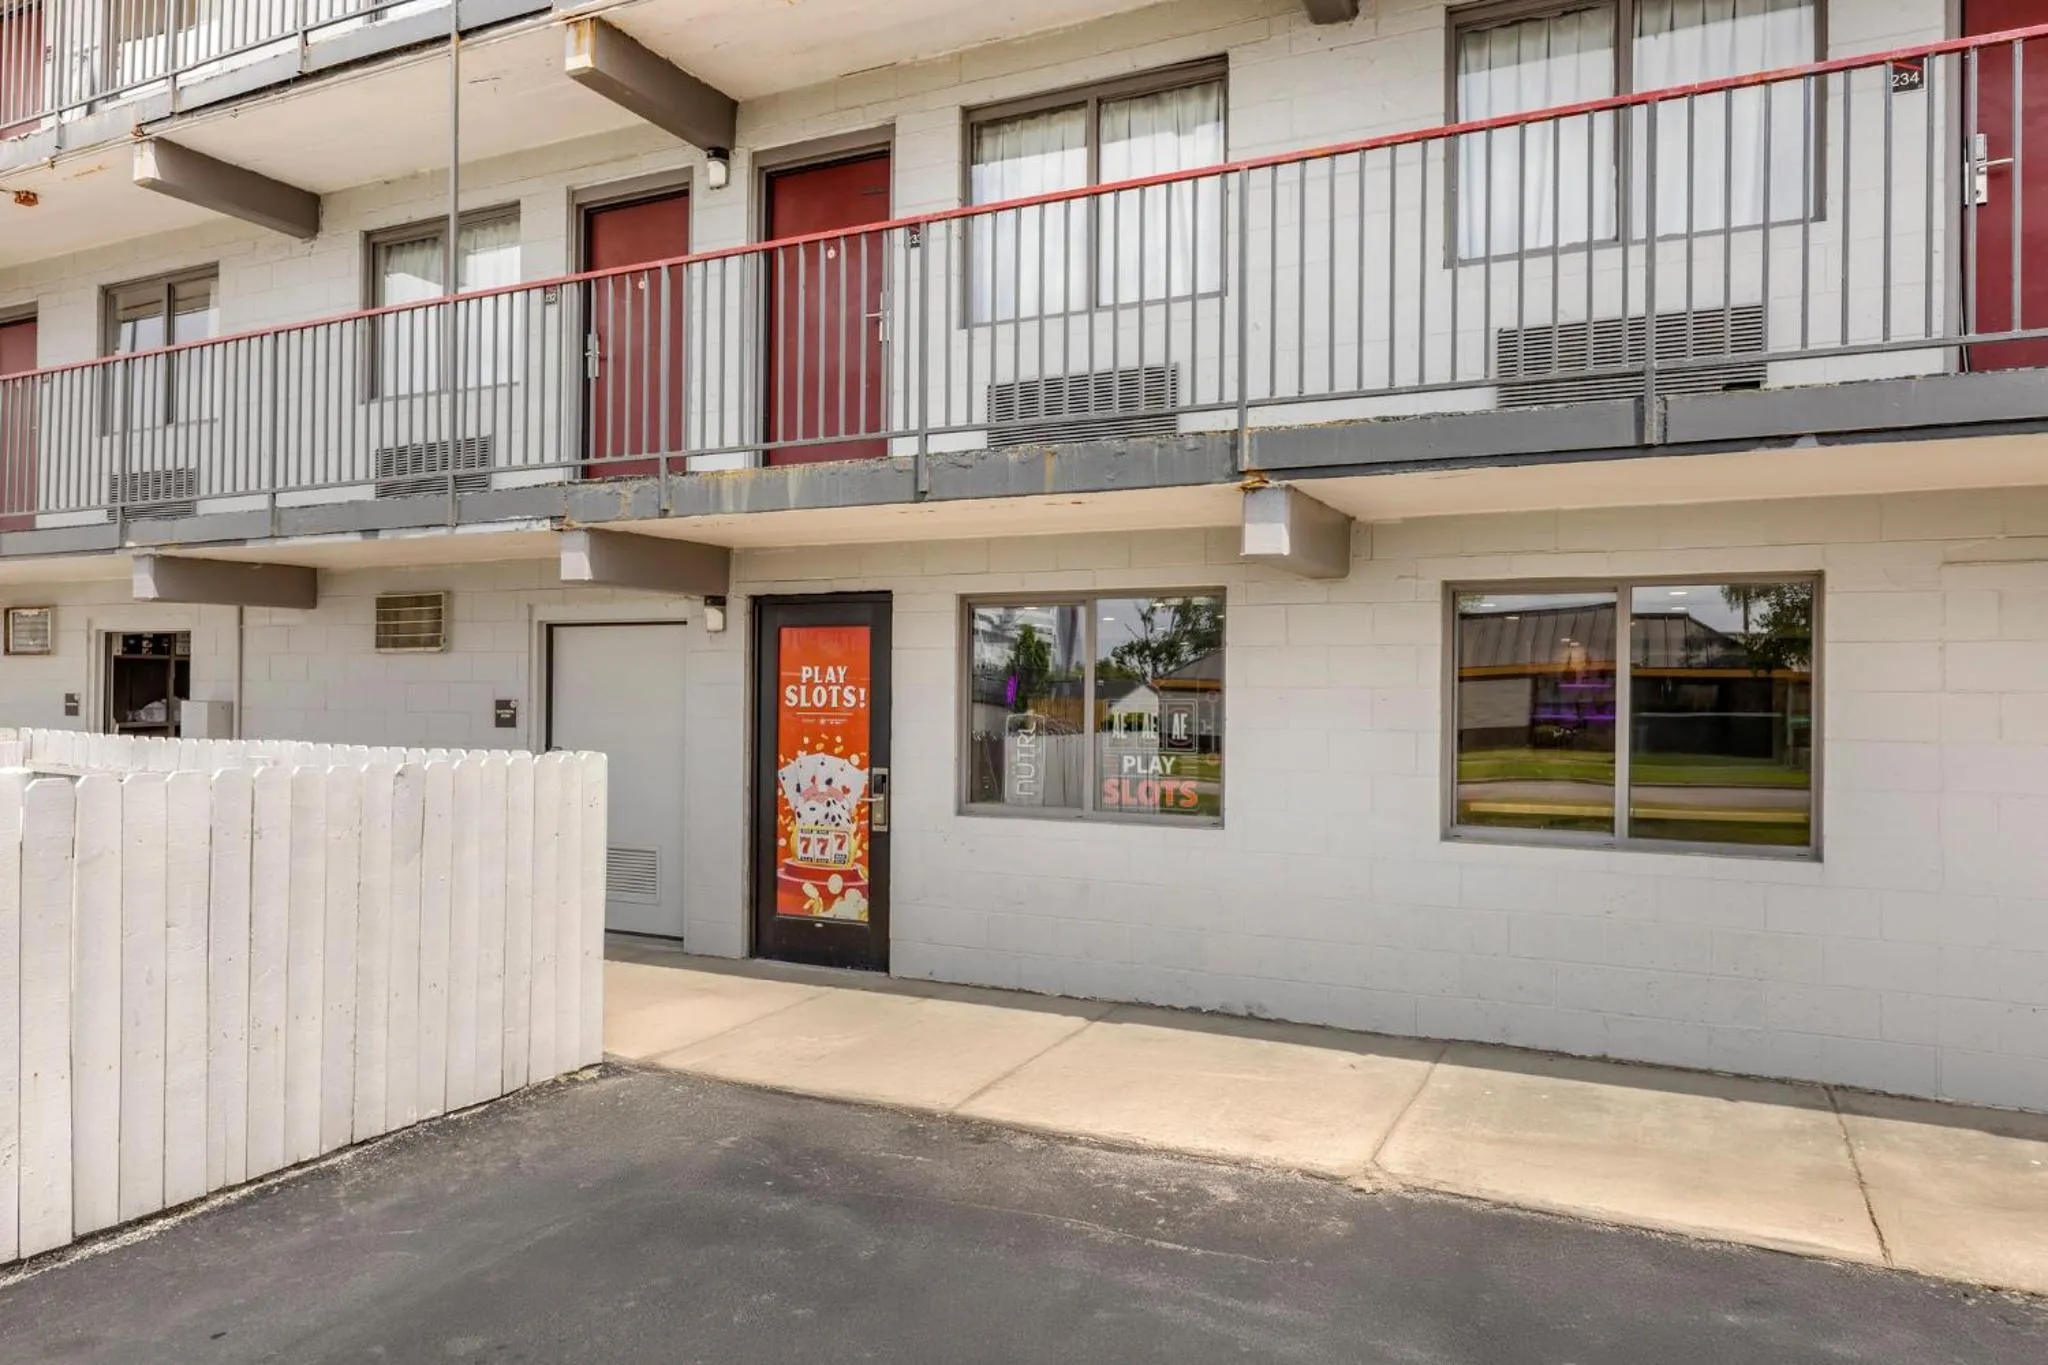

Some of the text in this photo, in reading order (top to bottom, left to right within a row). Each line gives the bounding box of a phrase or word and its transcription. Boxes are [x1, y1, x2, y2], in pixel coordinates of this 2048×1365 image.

[1891, 71, 1920, 87] 234
[800, 665, 848, 683] PLAY
[784, 685, 867, 708] SLOTS!
[1172, 712, 1189, 740] AE
[1123, 755, 1177, 776] PLAY
[1103, 778, 1199, 808] SLOTS
